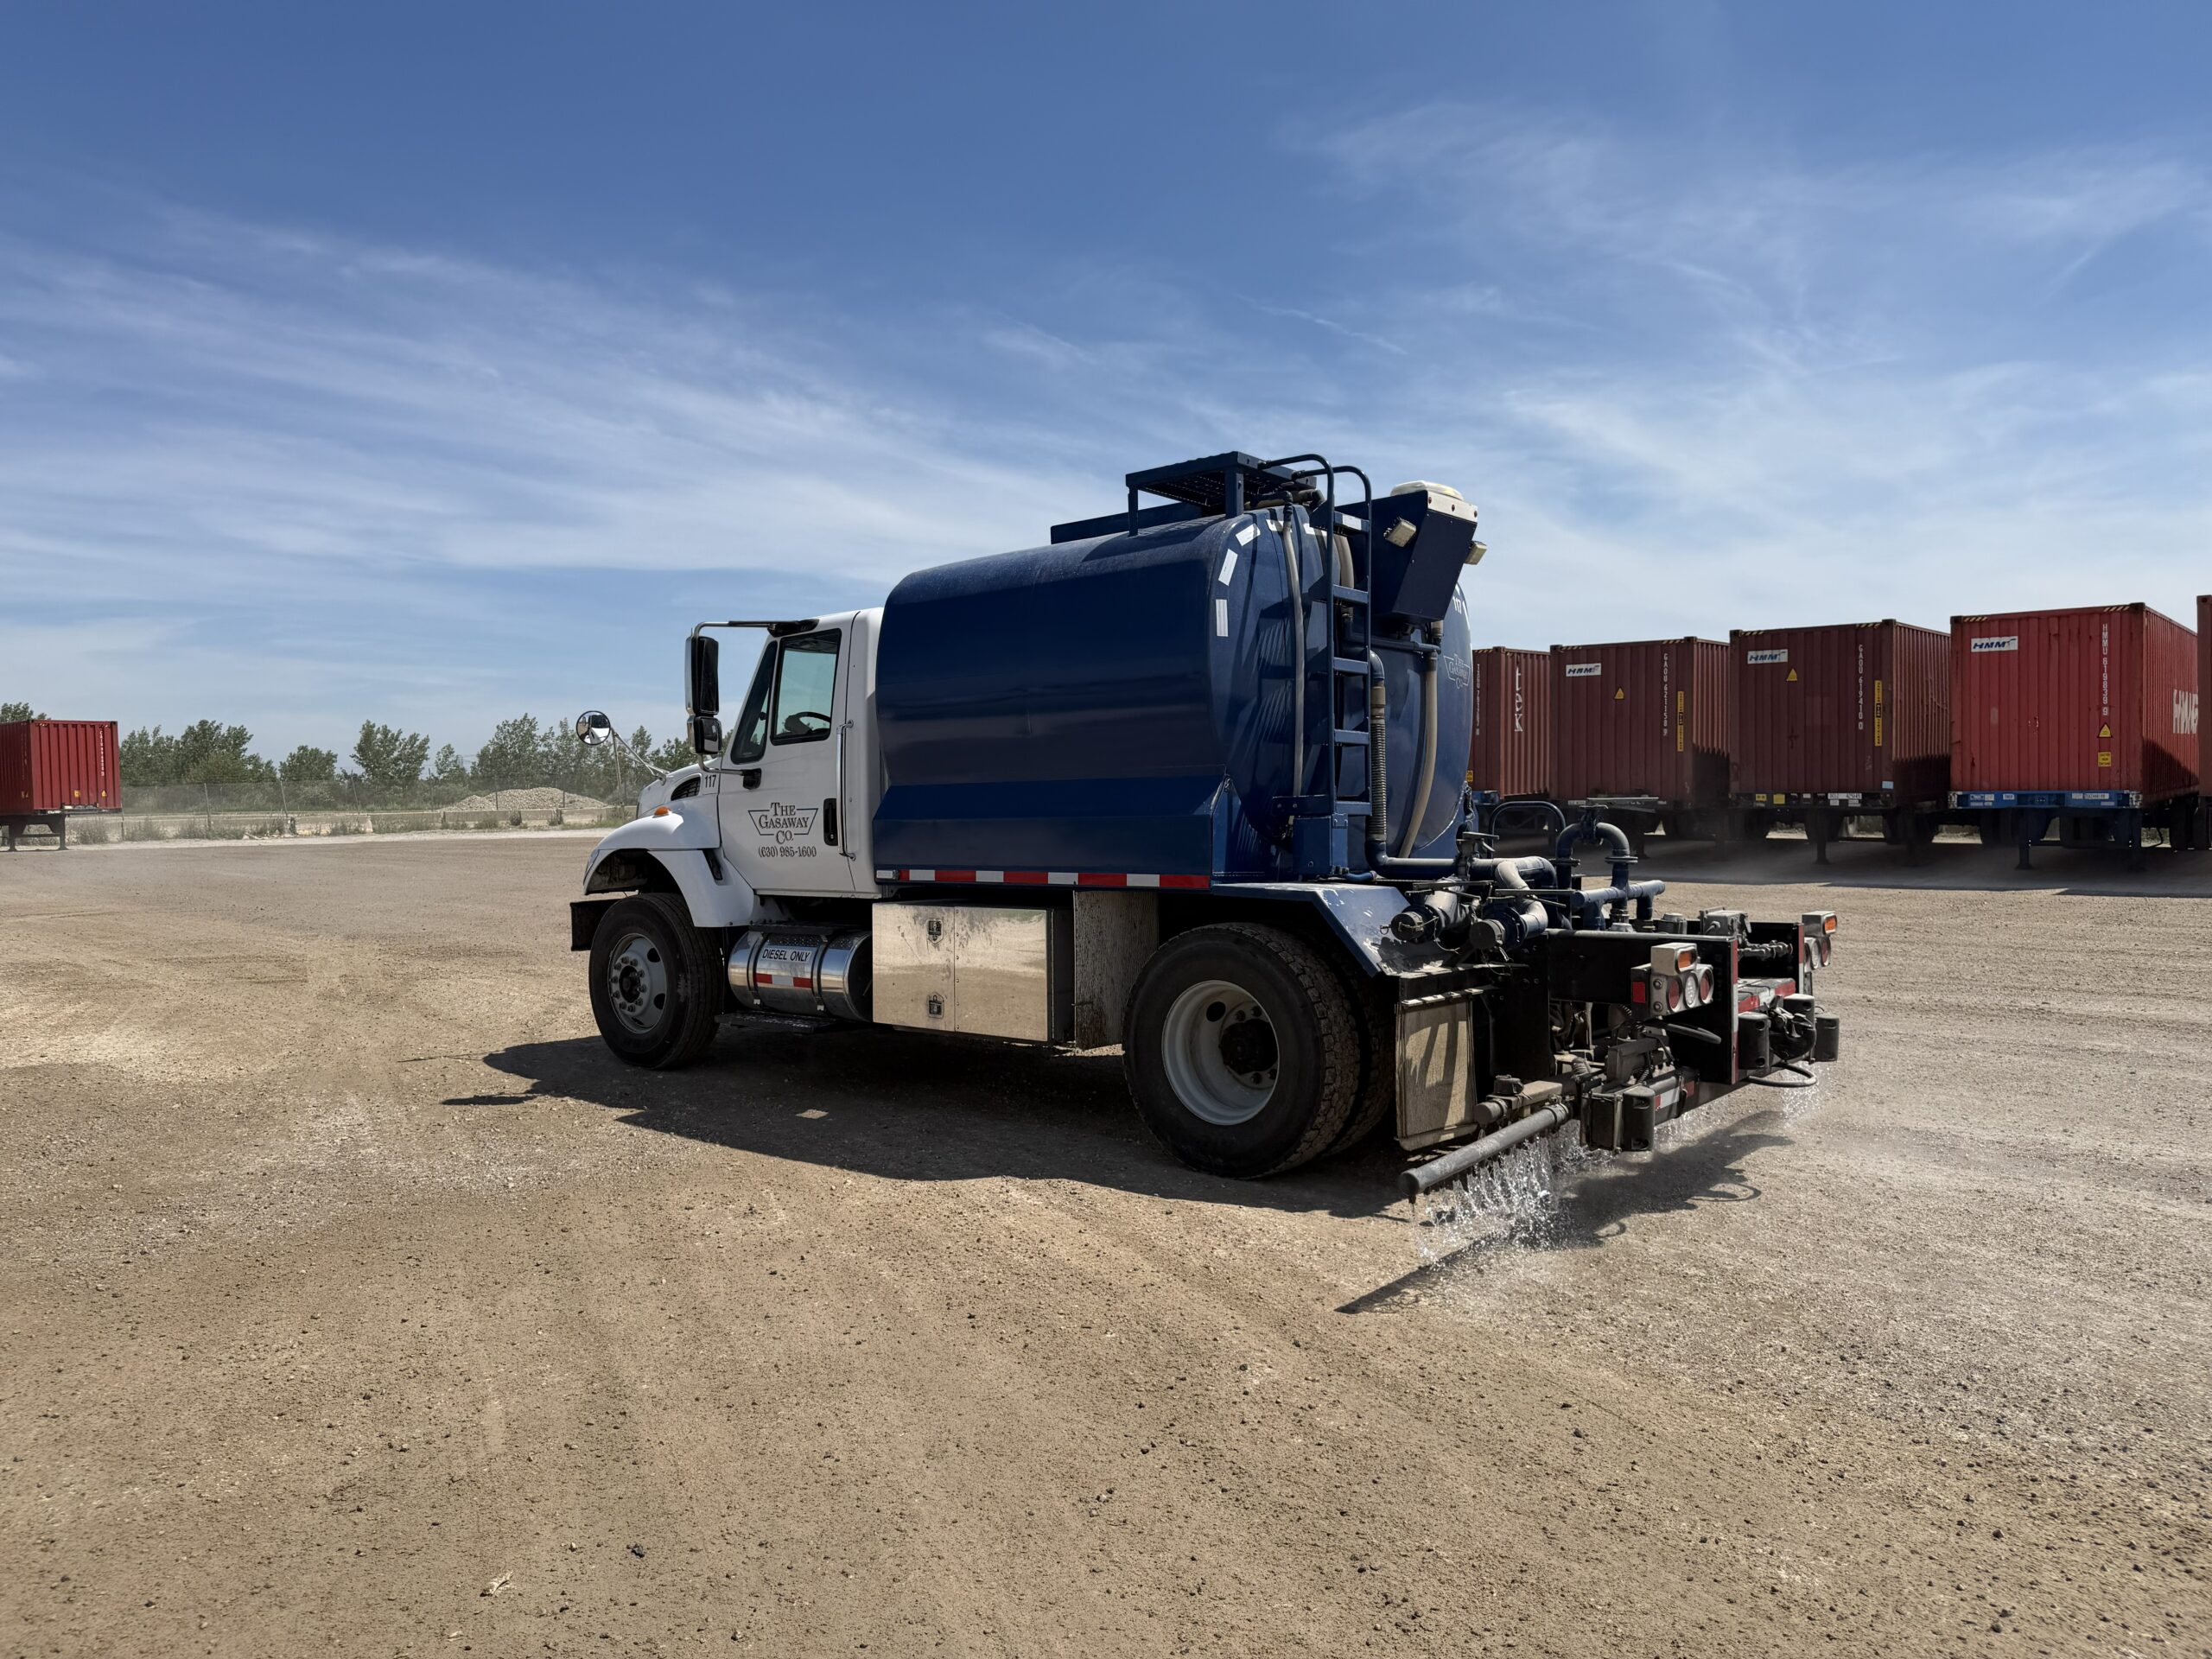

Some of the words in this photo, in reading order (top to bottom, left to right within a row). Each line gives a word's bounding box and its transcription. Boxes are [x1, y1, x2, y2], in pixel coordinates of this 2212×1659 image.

[1973, 641, 2006, 650] HMM
[704, 774, 717, 789] 117
[770, 802, 796, 817] THE
[759, 815, 810, 829] GASAWAY
[776, 830, 794, 844] CO.
[758, 846, 779, 858] (630)
[779, 846, 817, 858] 985-1600
[761, 949, 788, 961] DIESEL
[790, 950, 810, 962] ONLY
